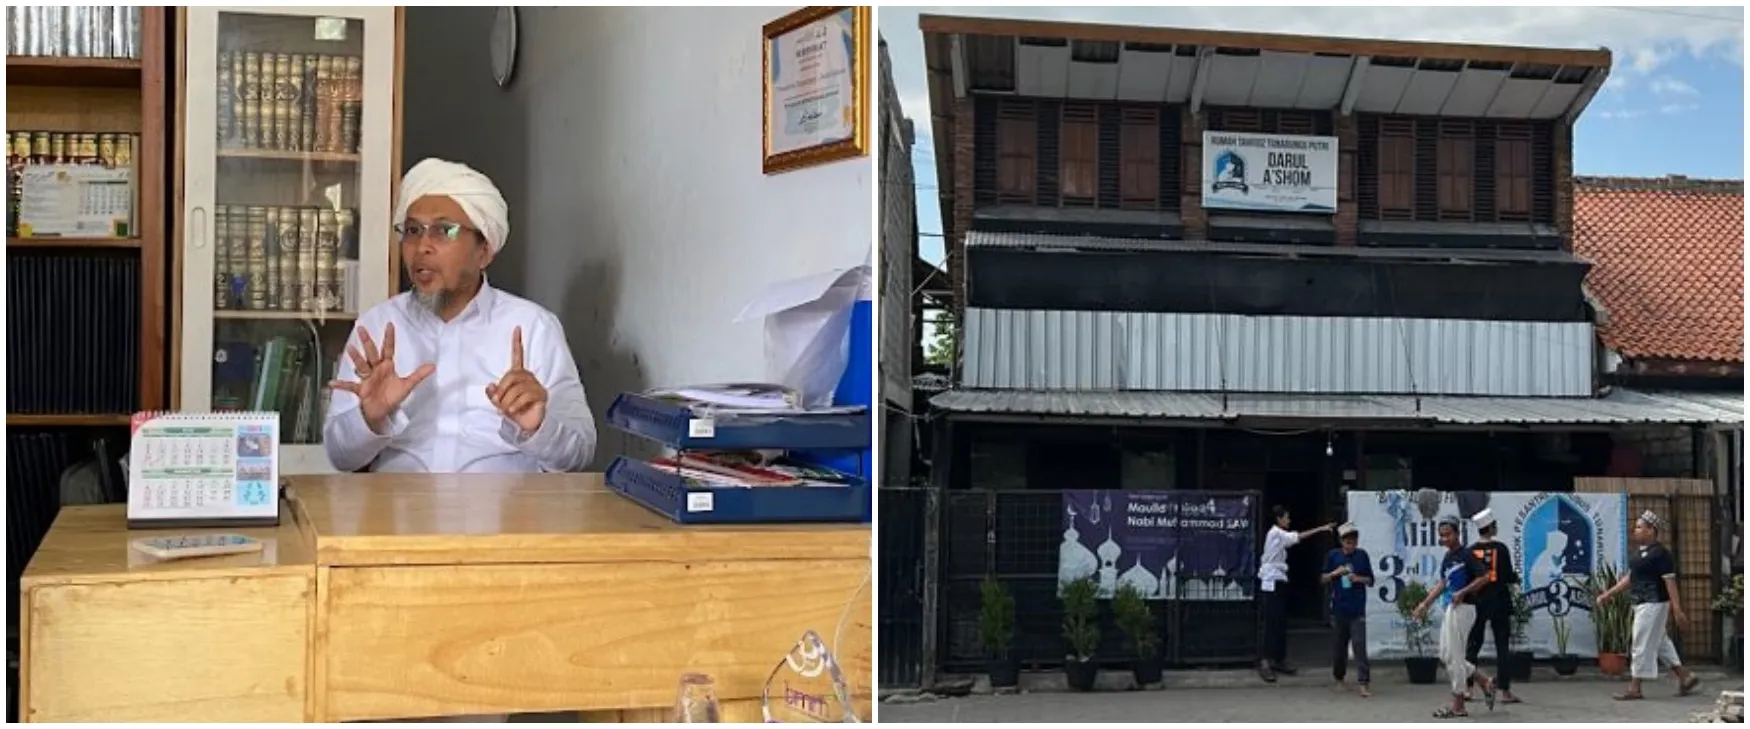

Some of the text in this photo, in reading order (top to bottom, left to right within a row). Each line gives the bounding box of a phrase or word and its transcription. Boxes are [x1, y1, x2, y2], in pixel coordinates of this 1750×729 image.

[1267, 152, 1309, 169] DARUL
[1126, 516, 1155, 528] Nabi
[1549, 580, 1570, 614] 3
